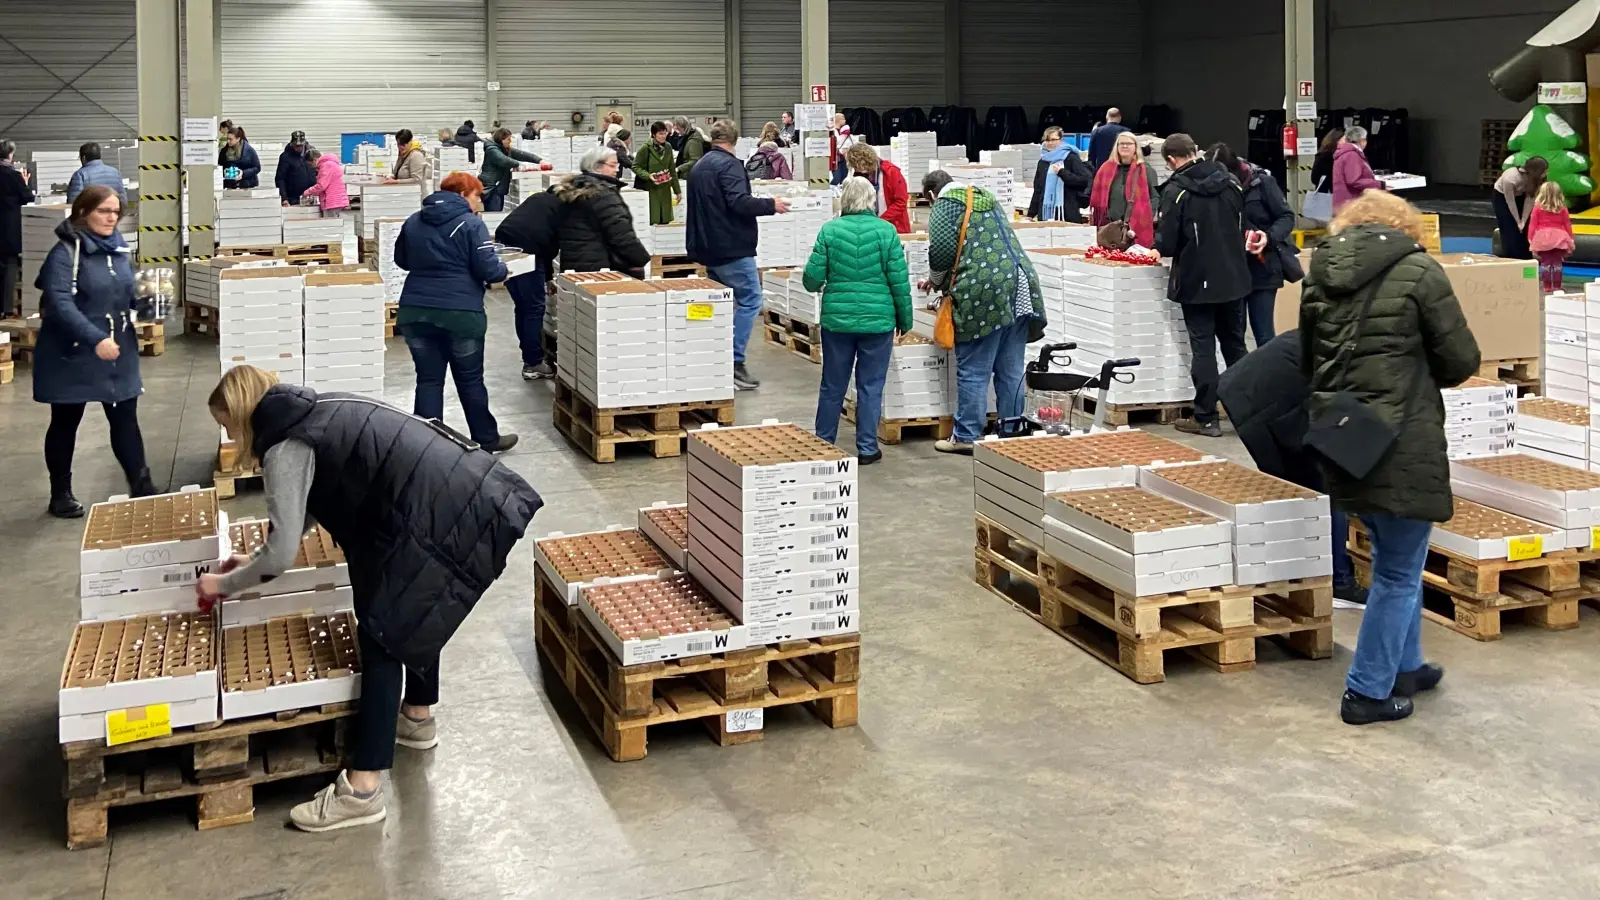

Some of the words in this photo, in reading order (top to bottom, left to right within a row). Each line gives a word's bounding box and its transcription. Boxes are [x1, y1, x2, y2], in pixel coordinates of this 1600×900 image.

[723, 291, 731, 299] W
[1505, 389, 1514, 399] W
[1506, 405, 1514, 414] W
[1506, 422, 1515, 432] W
[1506, 439, 1515, 448] W
[837, 460, 849, 473] W
[839, 484, 851, 497] W
[836, 506, 849, 519] W
[836, 526, 849, 539] W
[836, 548, 848, 560] W
[837, 571, 849, 584] W
[836, 594, 848, 607] W
[838, 615, 850, 628] W
[715, 634, 728, 648] W
